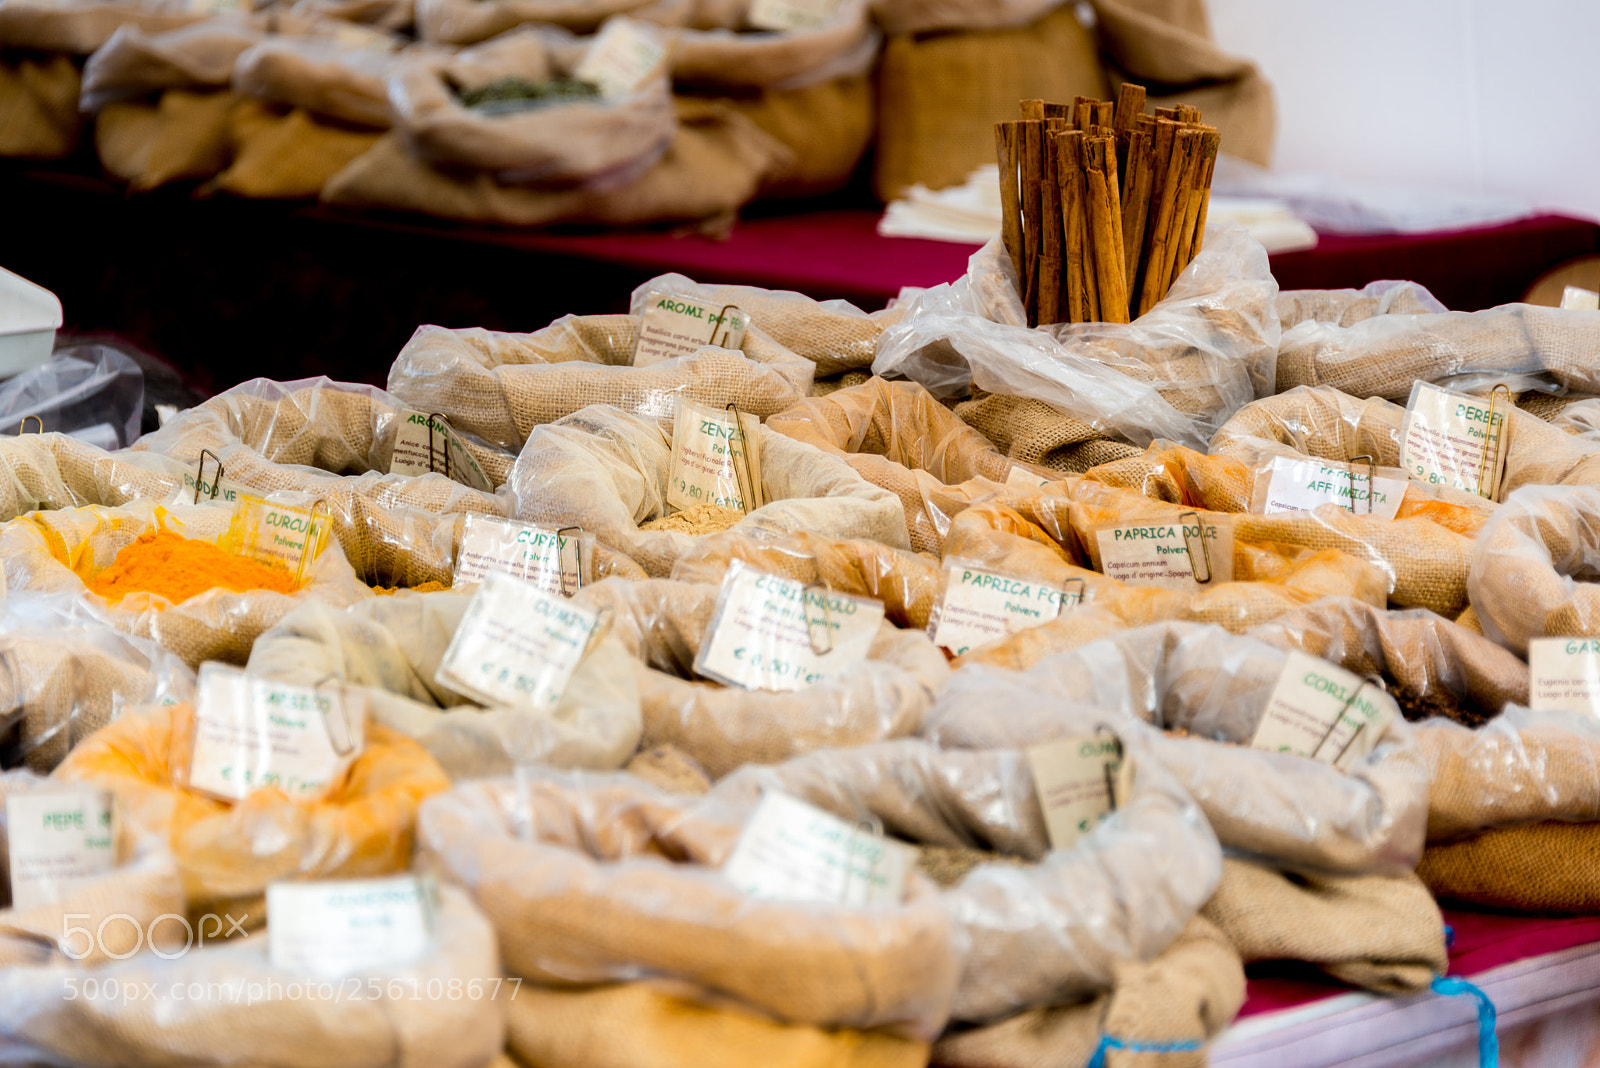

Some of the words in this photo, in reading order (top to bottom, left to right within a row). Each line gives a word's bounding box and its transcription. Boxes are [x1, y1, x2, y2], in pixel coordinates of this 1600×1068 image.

[657, 299, 704, 319] AROMI
[407, 414, 449, 437] AROMI
[400, 440, 419, 449] Anice
[395, 456, 415, 467] Luogo
[184, 473, 219, 497] BRODO
[1307, 480, 1387, 504] AFFUMICATA
[1271, 500, 1299, 512] Capsicum
[274, 534, 303, 550] Polvere
[1115, 527, 1175, 541] PAPRICA
[1107, 561, 1140, 570] Capsicum
[962, 570, 1031, 598] PAPRICA
[1004, 601, 1040, 618] Polvere
